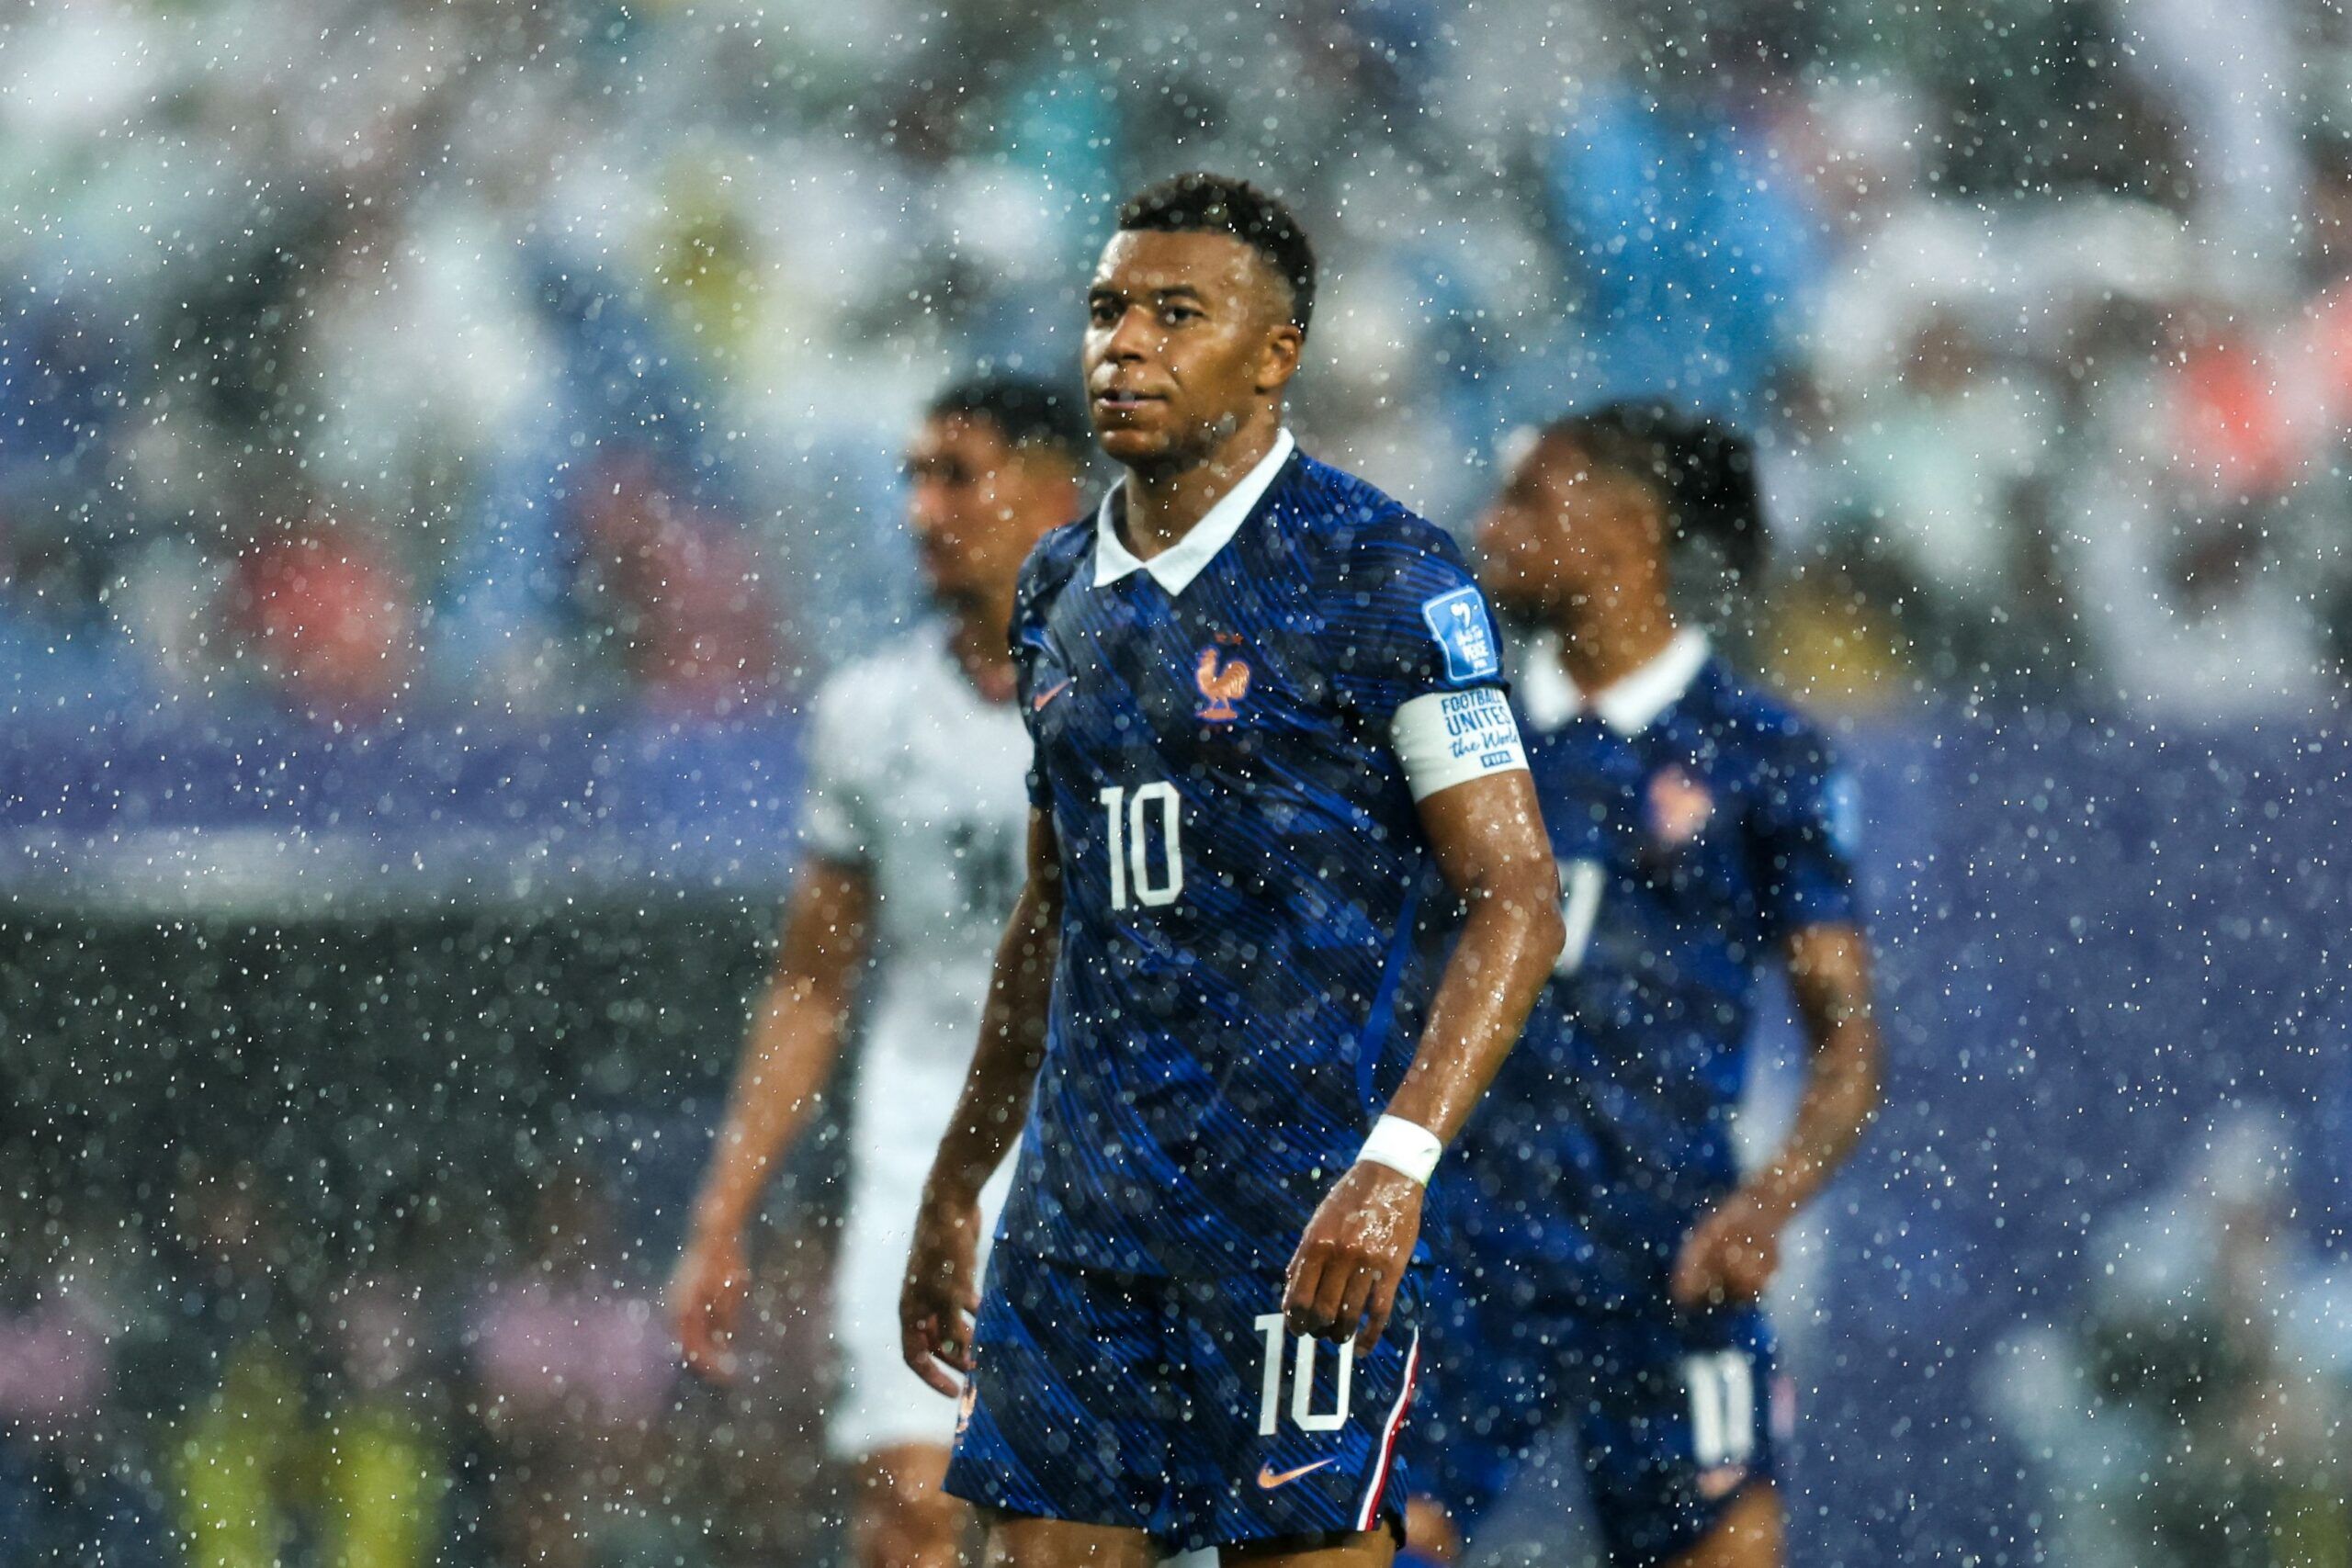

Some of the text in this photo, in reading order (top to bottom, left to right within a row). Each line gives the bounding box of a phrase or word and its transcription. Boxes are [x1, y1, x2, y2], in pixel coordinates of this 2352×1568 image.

[1445, 705, 1511, 736] UNITES
[1449, 738, 1480, 758] the
[1100, 781, 1183, 911] 10
[1254, 1313, 1358, 1435] 10
